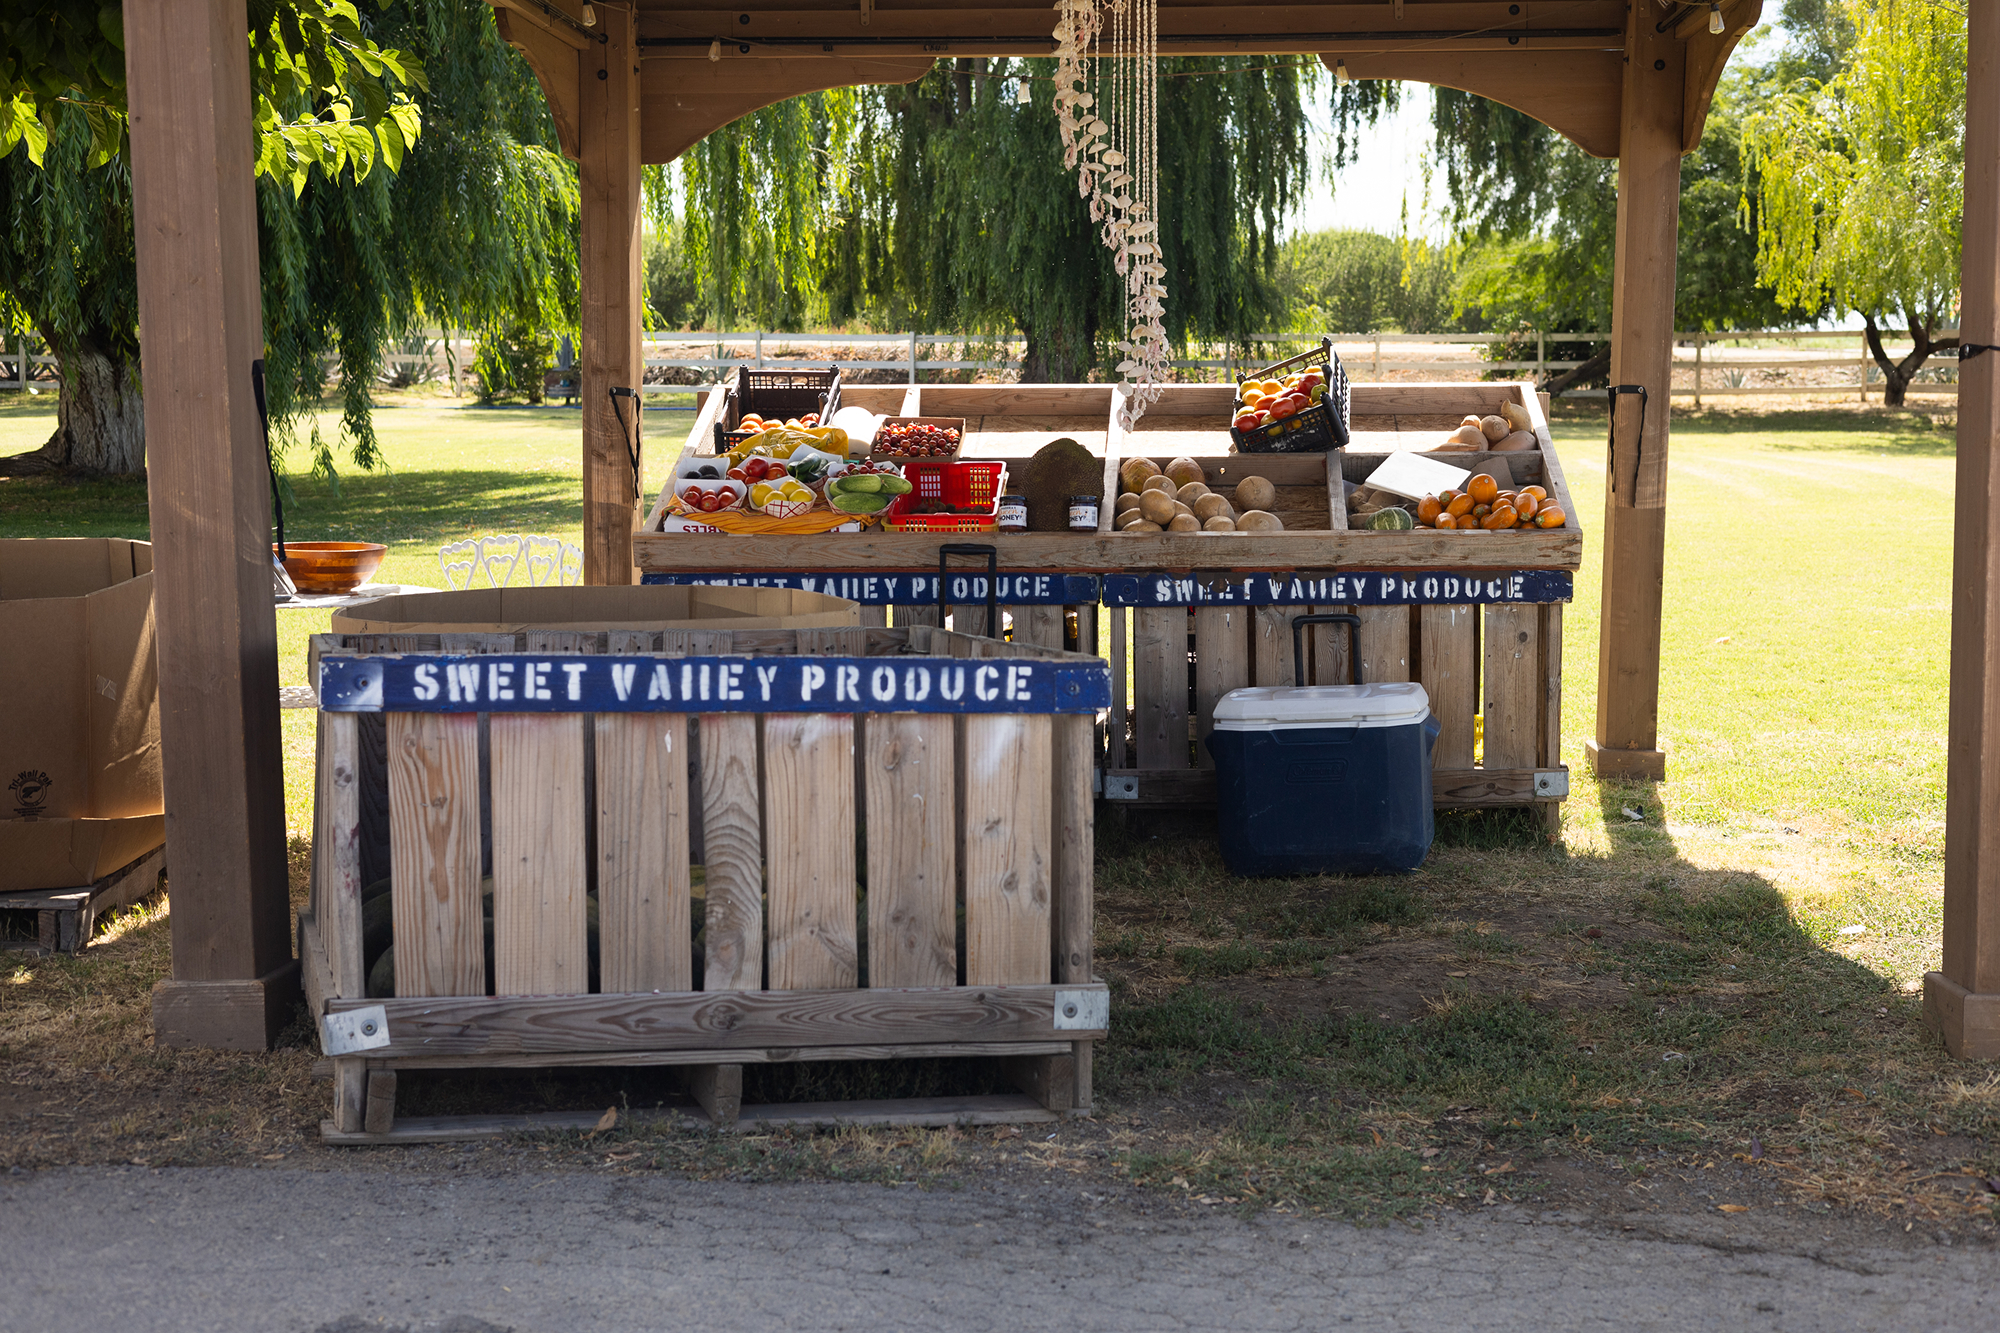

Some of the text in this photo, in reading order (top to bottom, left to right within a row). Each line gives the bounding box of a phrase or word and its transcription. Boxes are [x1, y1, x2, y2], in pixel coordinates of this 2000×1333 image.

[1381, 576, 1524, 599] PRODUCE
[413, 662, 587, 702] SWEET
[801, 664, 1032, 702] PRODUCE
